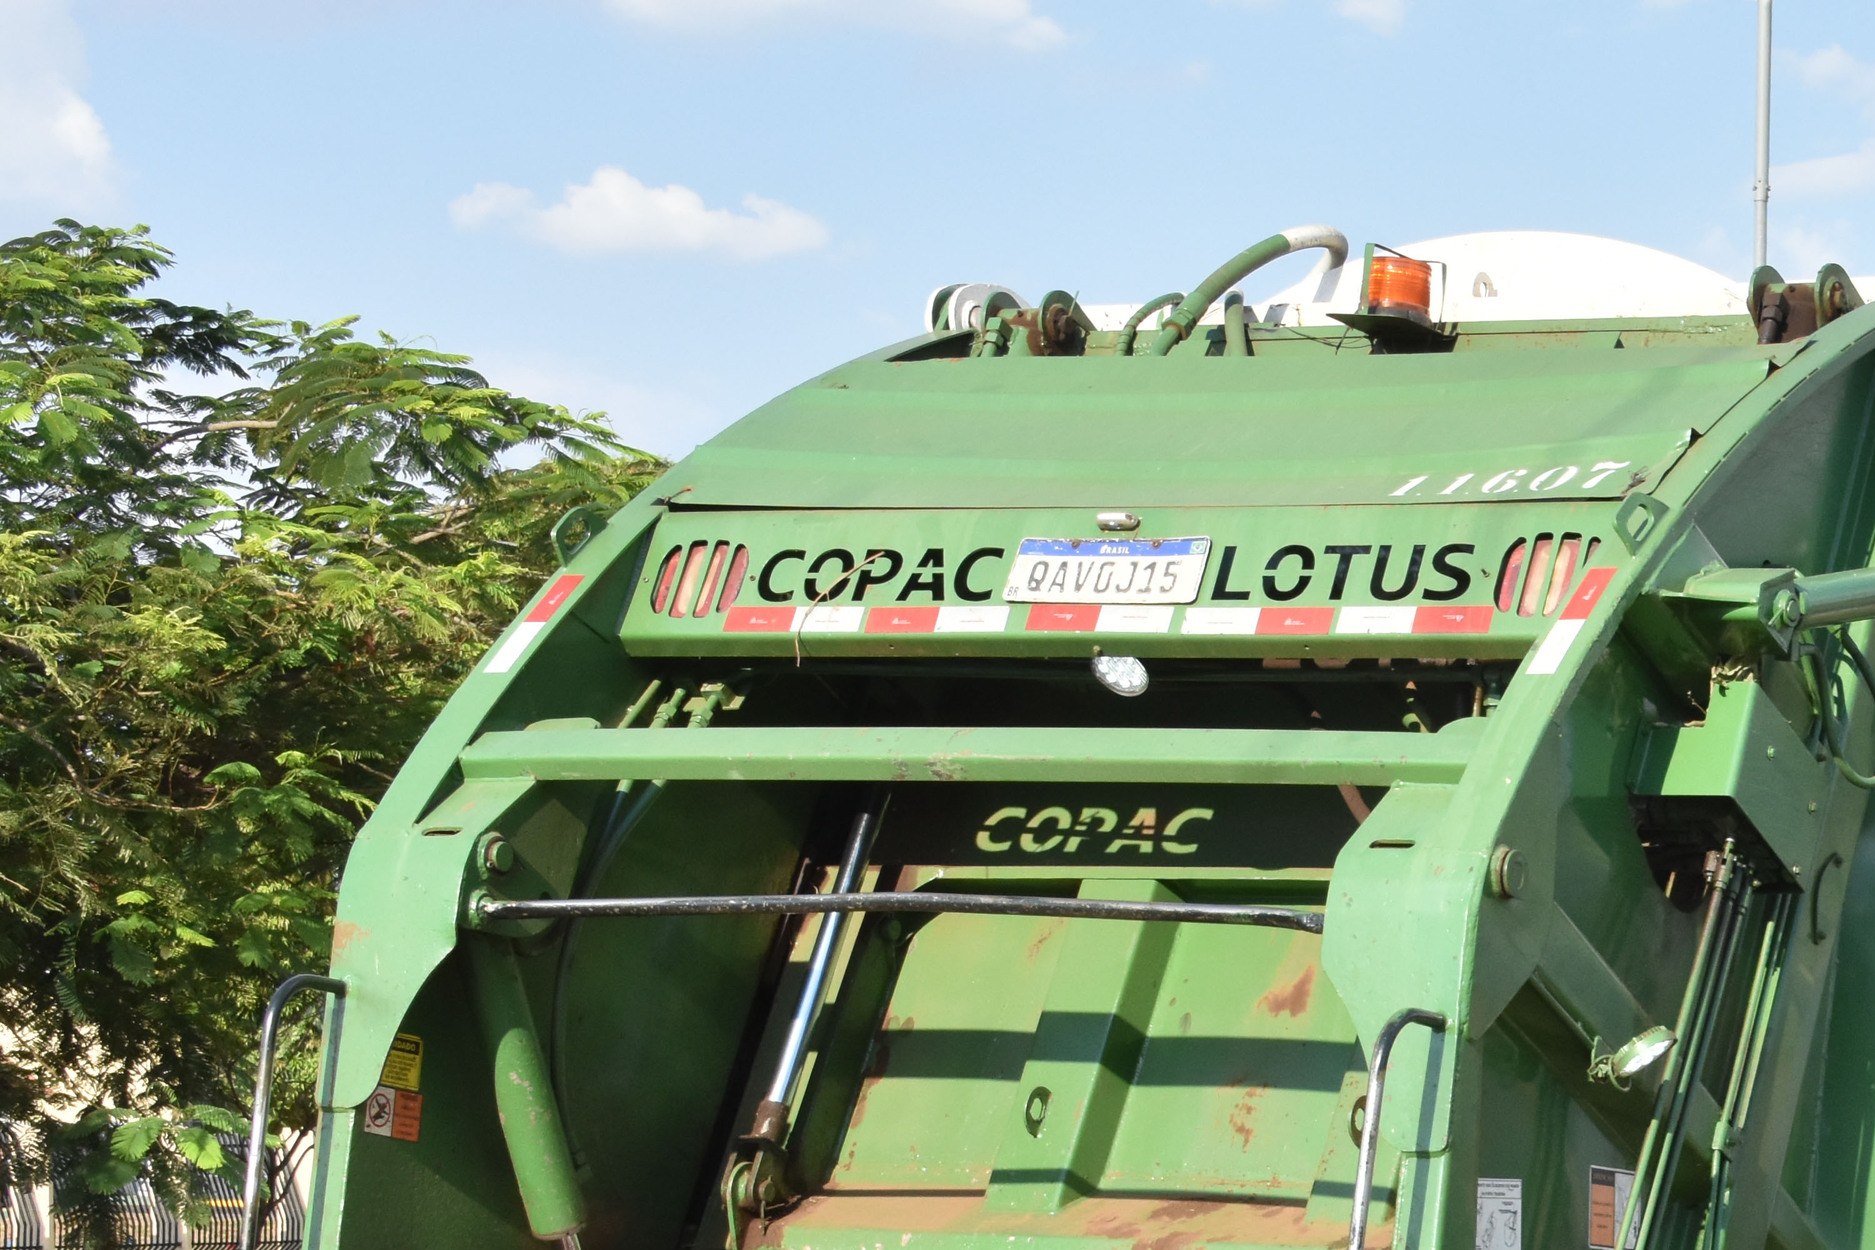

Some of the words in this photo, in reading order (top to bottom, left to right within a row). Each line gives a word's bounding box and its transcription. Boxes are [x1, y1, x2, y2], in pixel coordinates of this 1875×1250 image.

[755, 546, 1005, 602] COPAC
[1100, 545, 1130, 555] BRASIL
[1211, 543, 1477, 602] LOTUS
[975, 806, 1215, 854] COPAC
